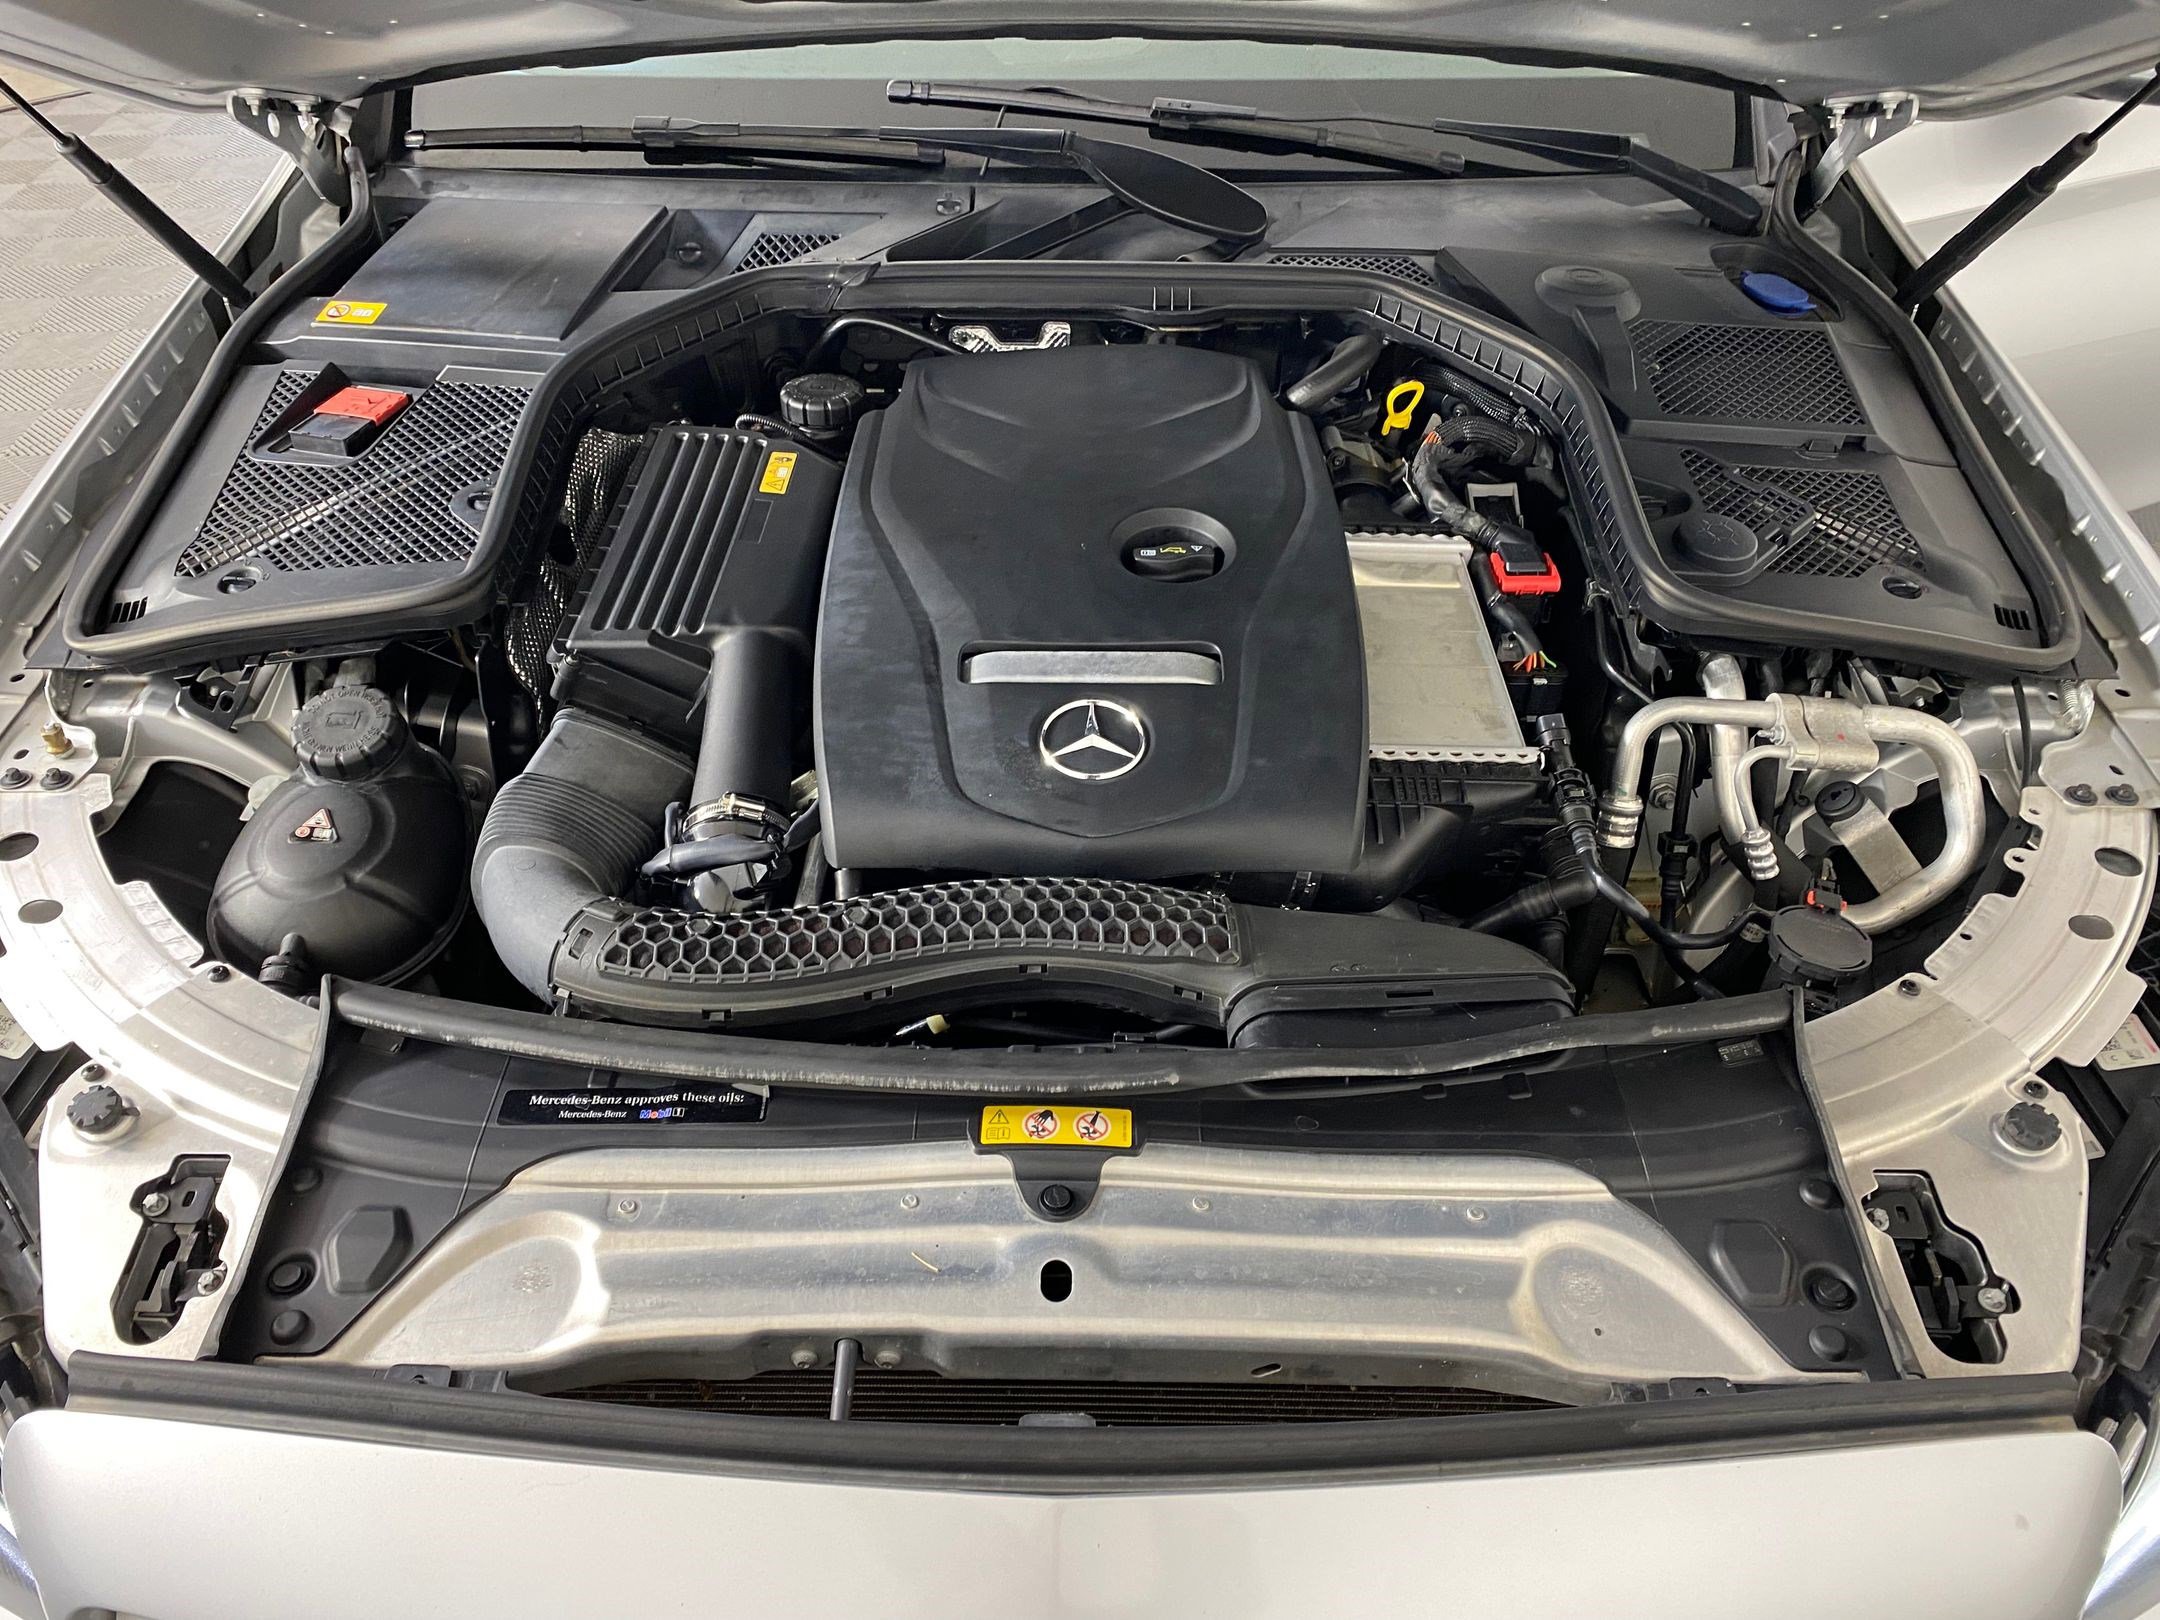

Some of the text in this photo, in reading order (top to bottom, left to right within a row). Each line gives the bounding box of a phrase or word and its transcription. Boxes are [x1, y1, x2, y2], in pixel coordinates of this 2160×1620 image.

[338, 689, 361, 698] OPEN
[529, 1092, 745, 1106] Mercedes-Benz approves these oils:
[558, 1110, 628, 1119] Mercedes-Benz
[639, 1107, 673, 1119] Mobil
